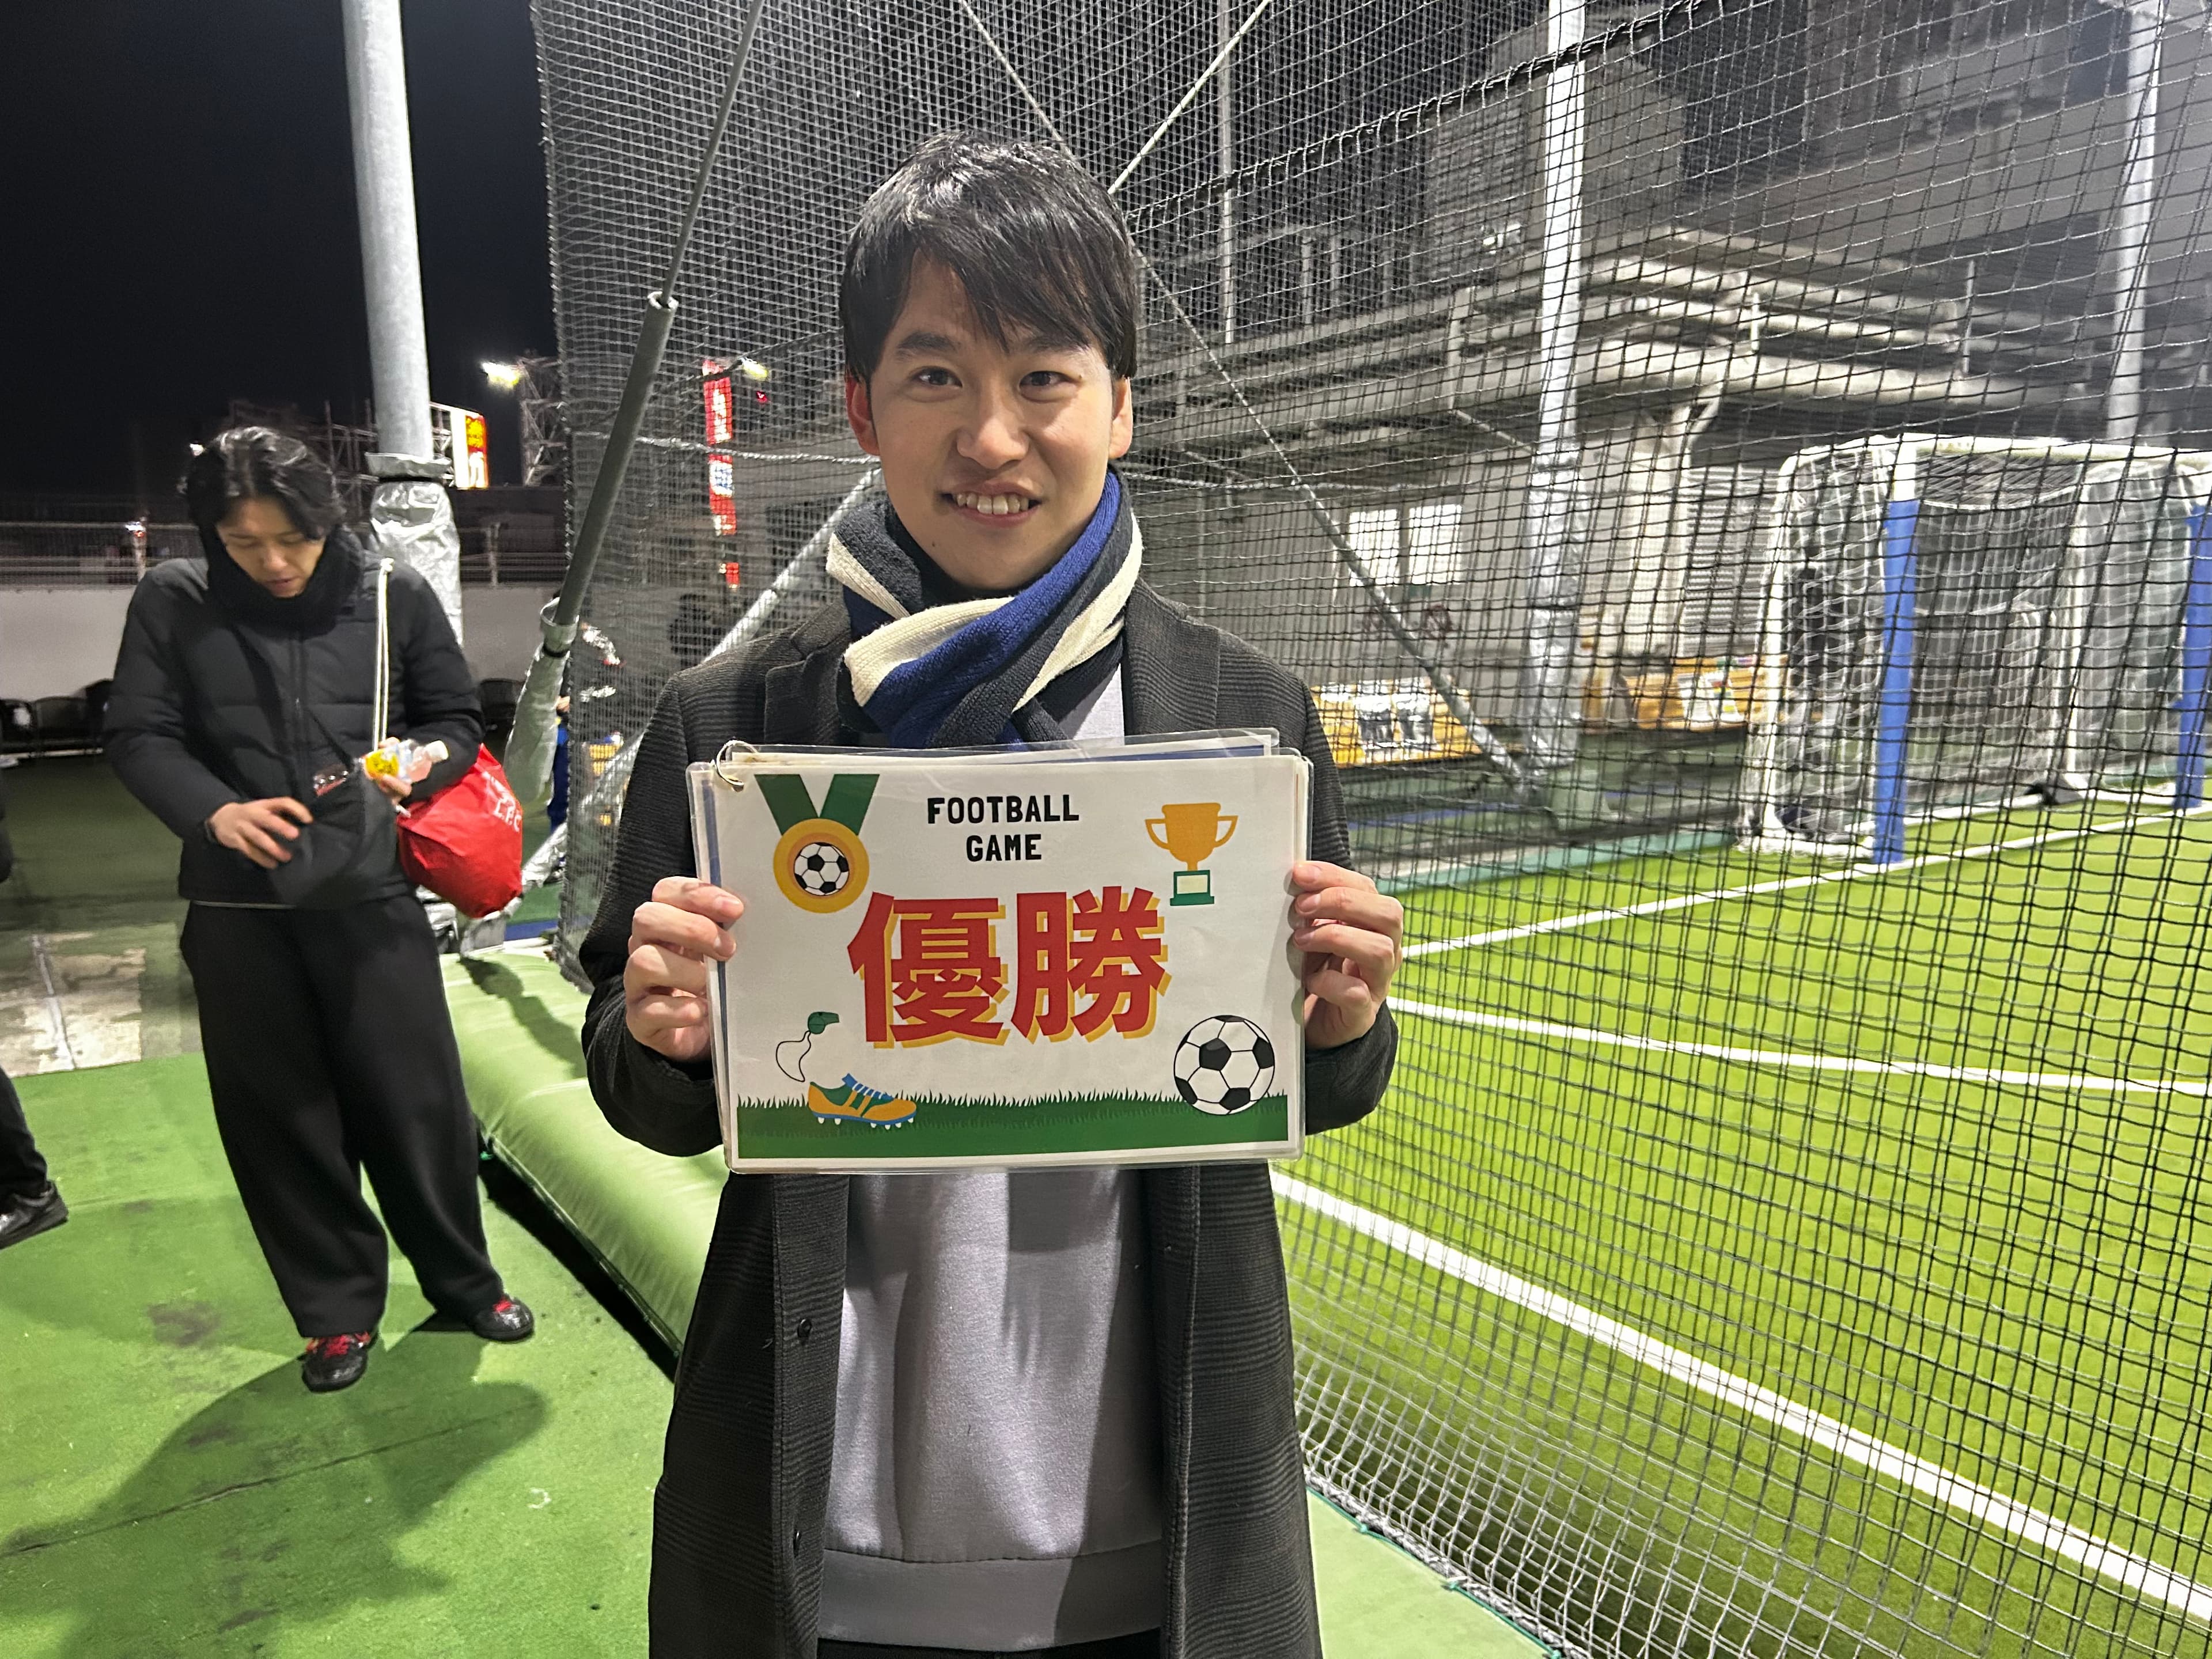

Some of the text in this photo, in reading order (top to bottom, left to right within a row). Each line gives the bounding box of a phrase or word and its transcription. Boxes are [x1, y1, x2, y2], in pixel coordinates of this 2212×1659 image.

[927, 794, 1080, 824] FOOTBALL
[966, 834, 1042, 862] GAME
[847, 885, 1172, 1048] 優勝
